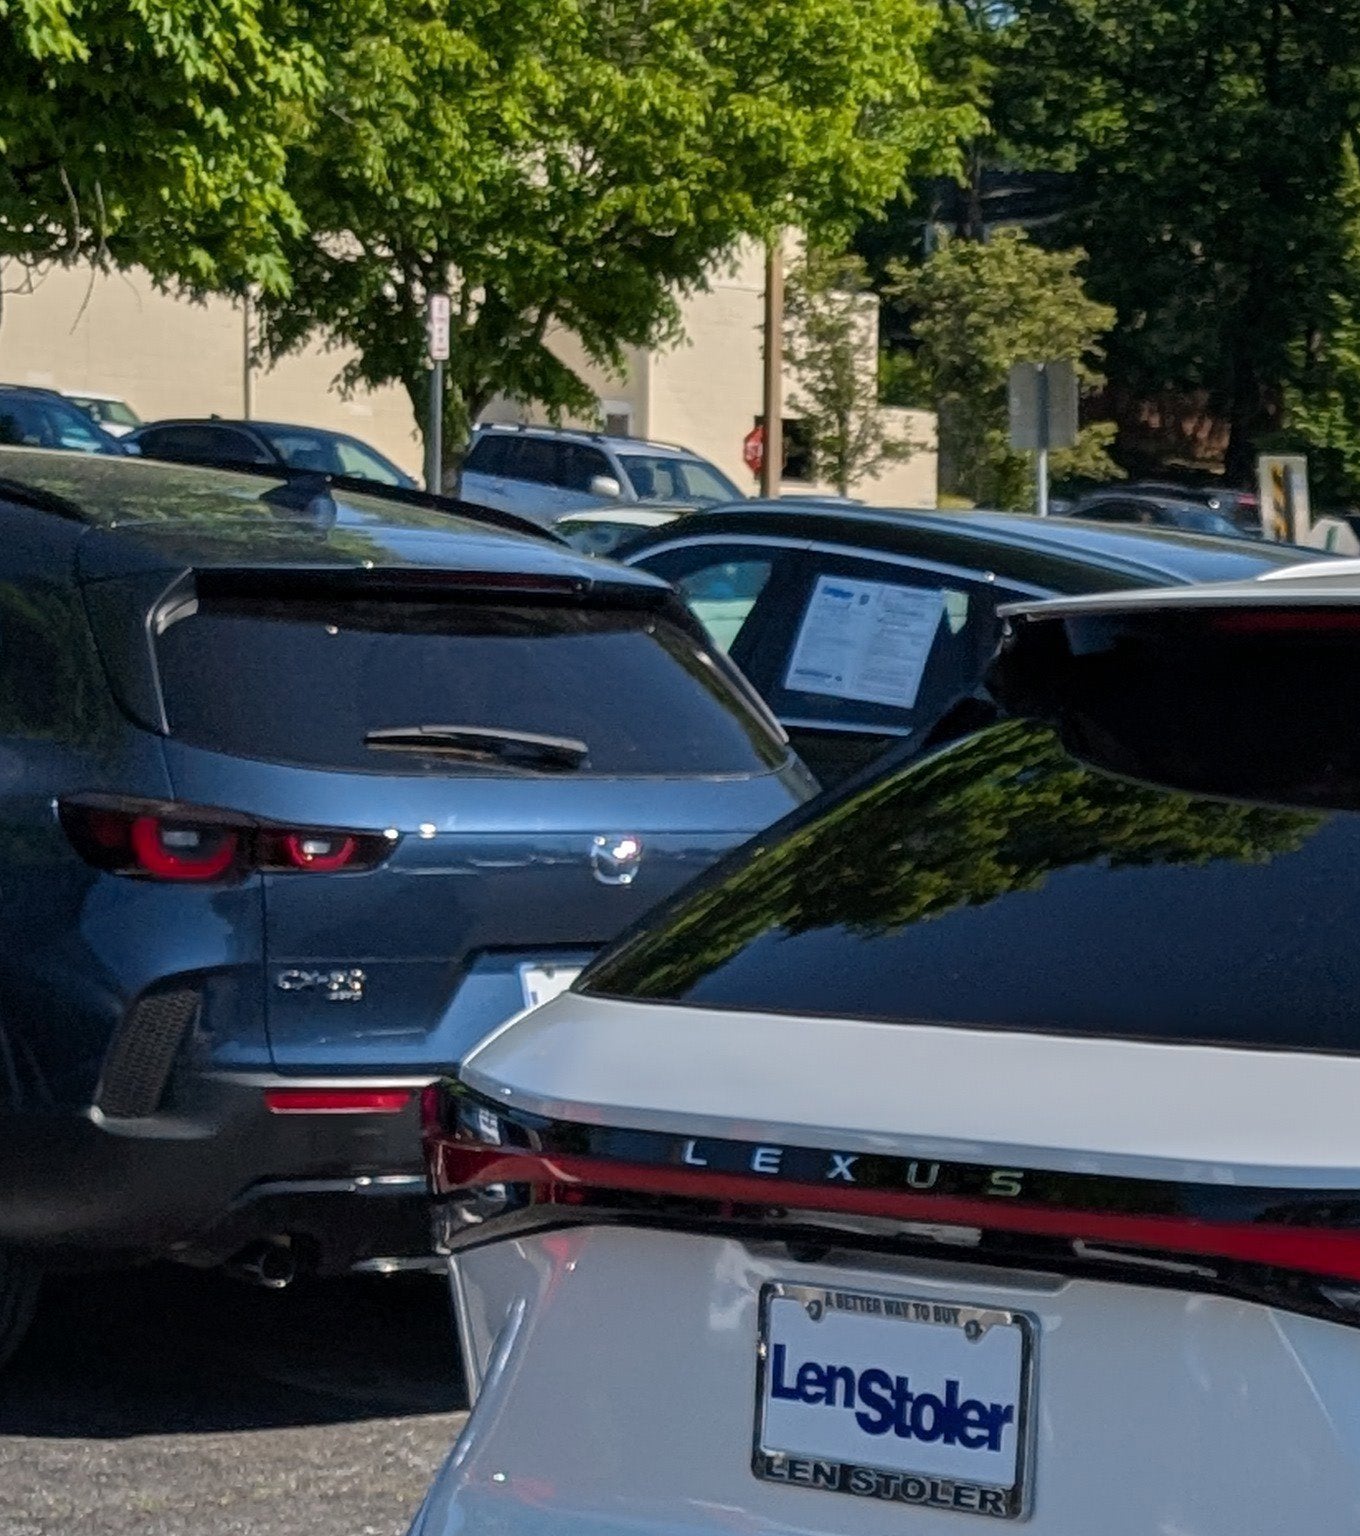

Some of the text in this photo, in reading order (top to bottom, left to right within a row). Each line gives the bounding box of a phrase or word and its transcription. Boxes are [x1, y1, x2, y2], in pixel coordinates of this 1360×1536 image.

[683, 1139, 1025, 1197] LEXUS
[825, 1292, 961, 1324] A BETTER WAY TO BUY
[765, 1456, 1007, 1515] LEN STOLER
